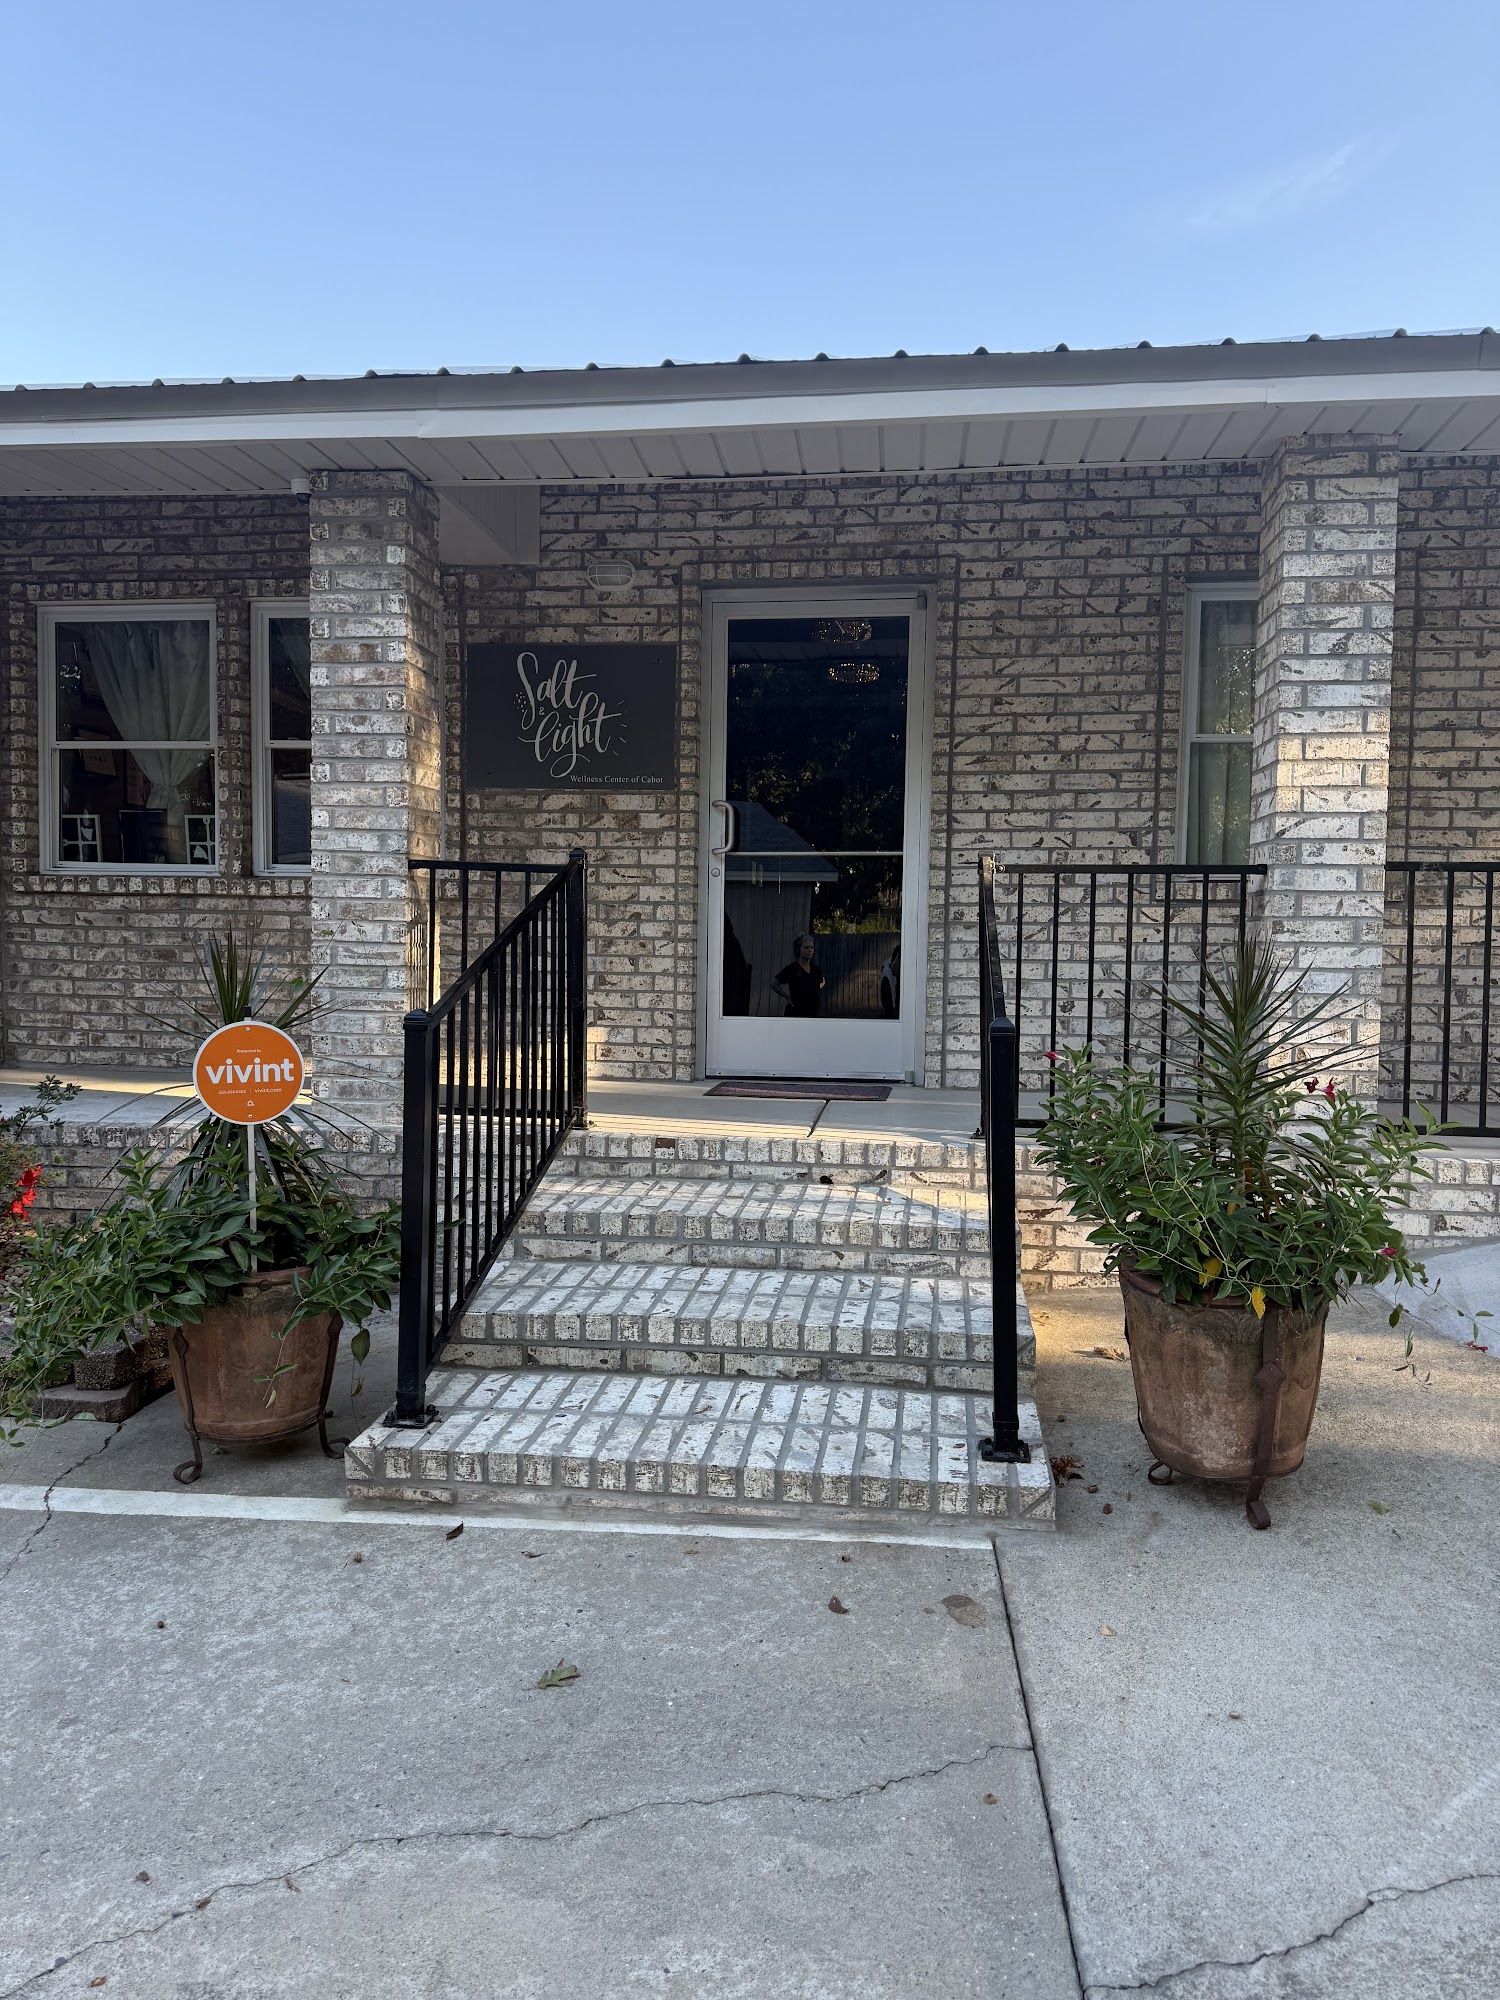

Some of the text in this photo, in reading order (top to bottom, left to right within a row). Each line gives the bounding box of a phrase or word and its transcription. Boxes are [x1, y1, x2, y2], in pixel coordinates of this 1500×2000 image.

[516, 651, 597, 730] Salt
[538, 706, 545, 716] &
[570, 775, 664, 784] Wellness Center of Cabot
[205, 1057, 294, 1084] vivint
